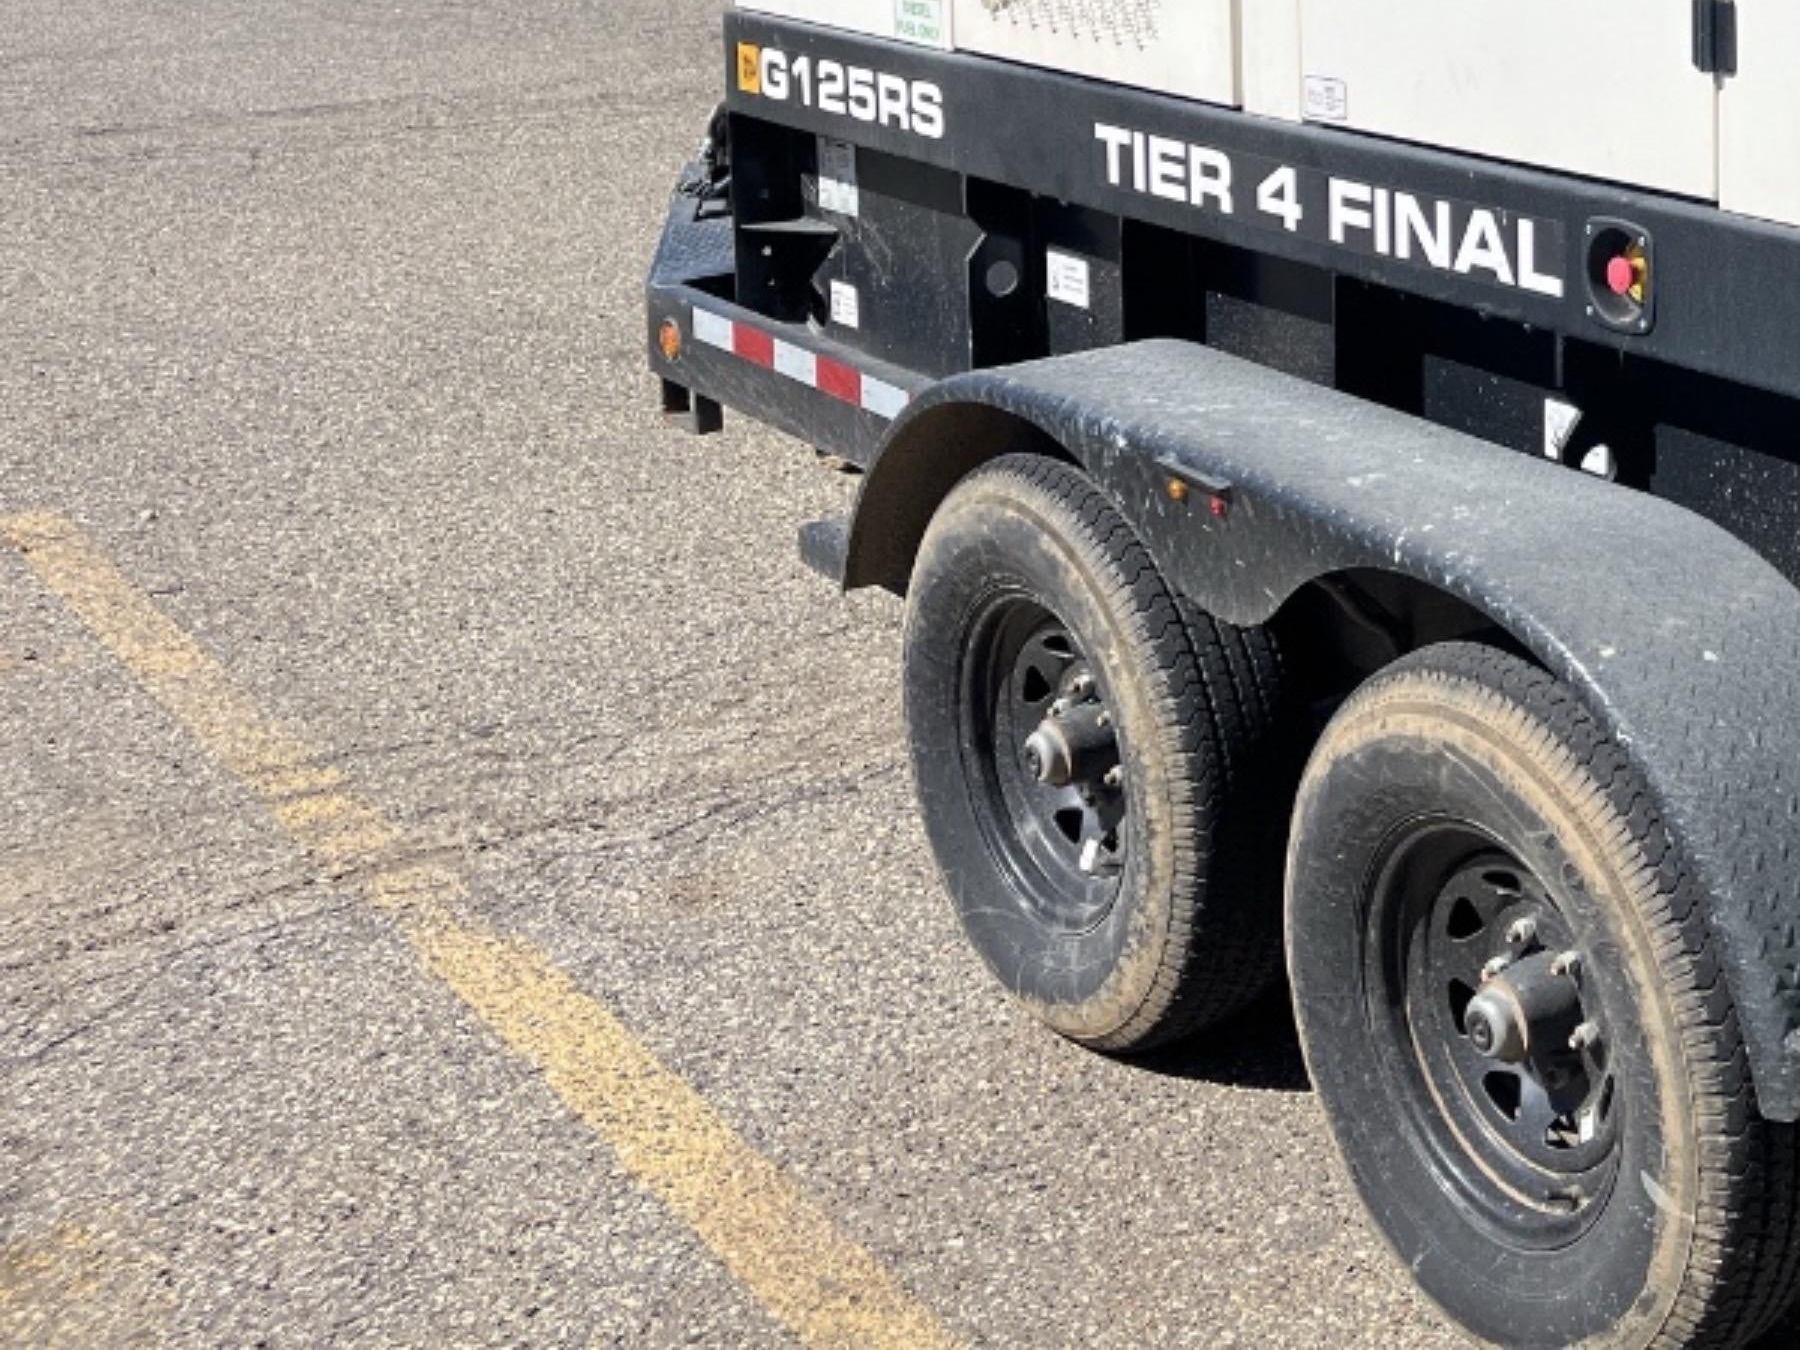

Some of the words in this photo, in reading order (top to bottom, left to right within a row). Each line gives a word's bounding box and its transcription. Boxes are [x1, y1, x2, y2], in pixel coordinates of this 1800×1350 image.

[760, 46, 945, 140] G125RS
[1093, 122, 1234, 214] TIER
[1256, 163, 1303, 232] 4
[1328, 175, 1564, 299] FINAL
